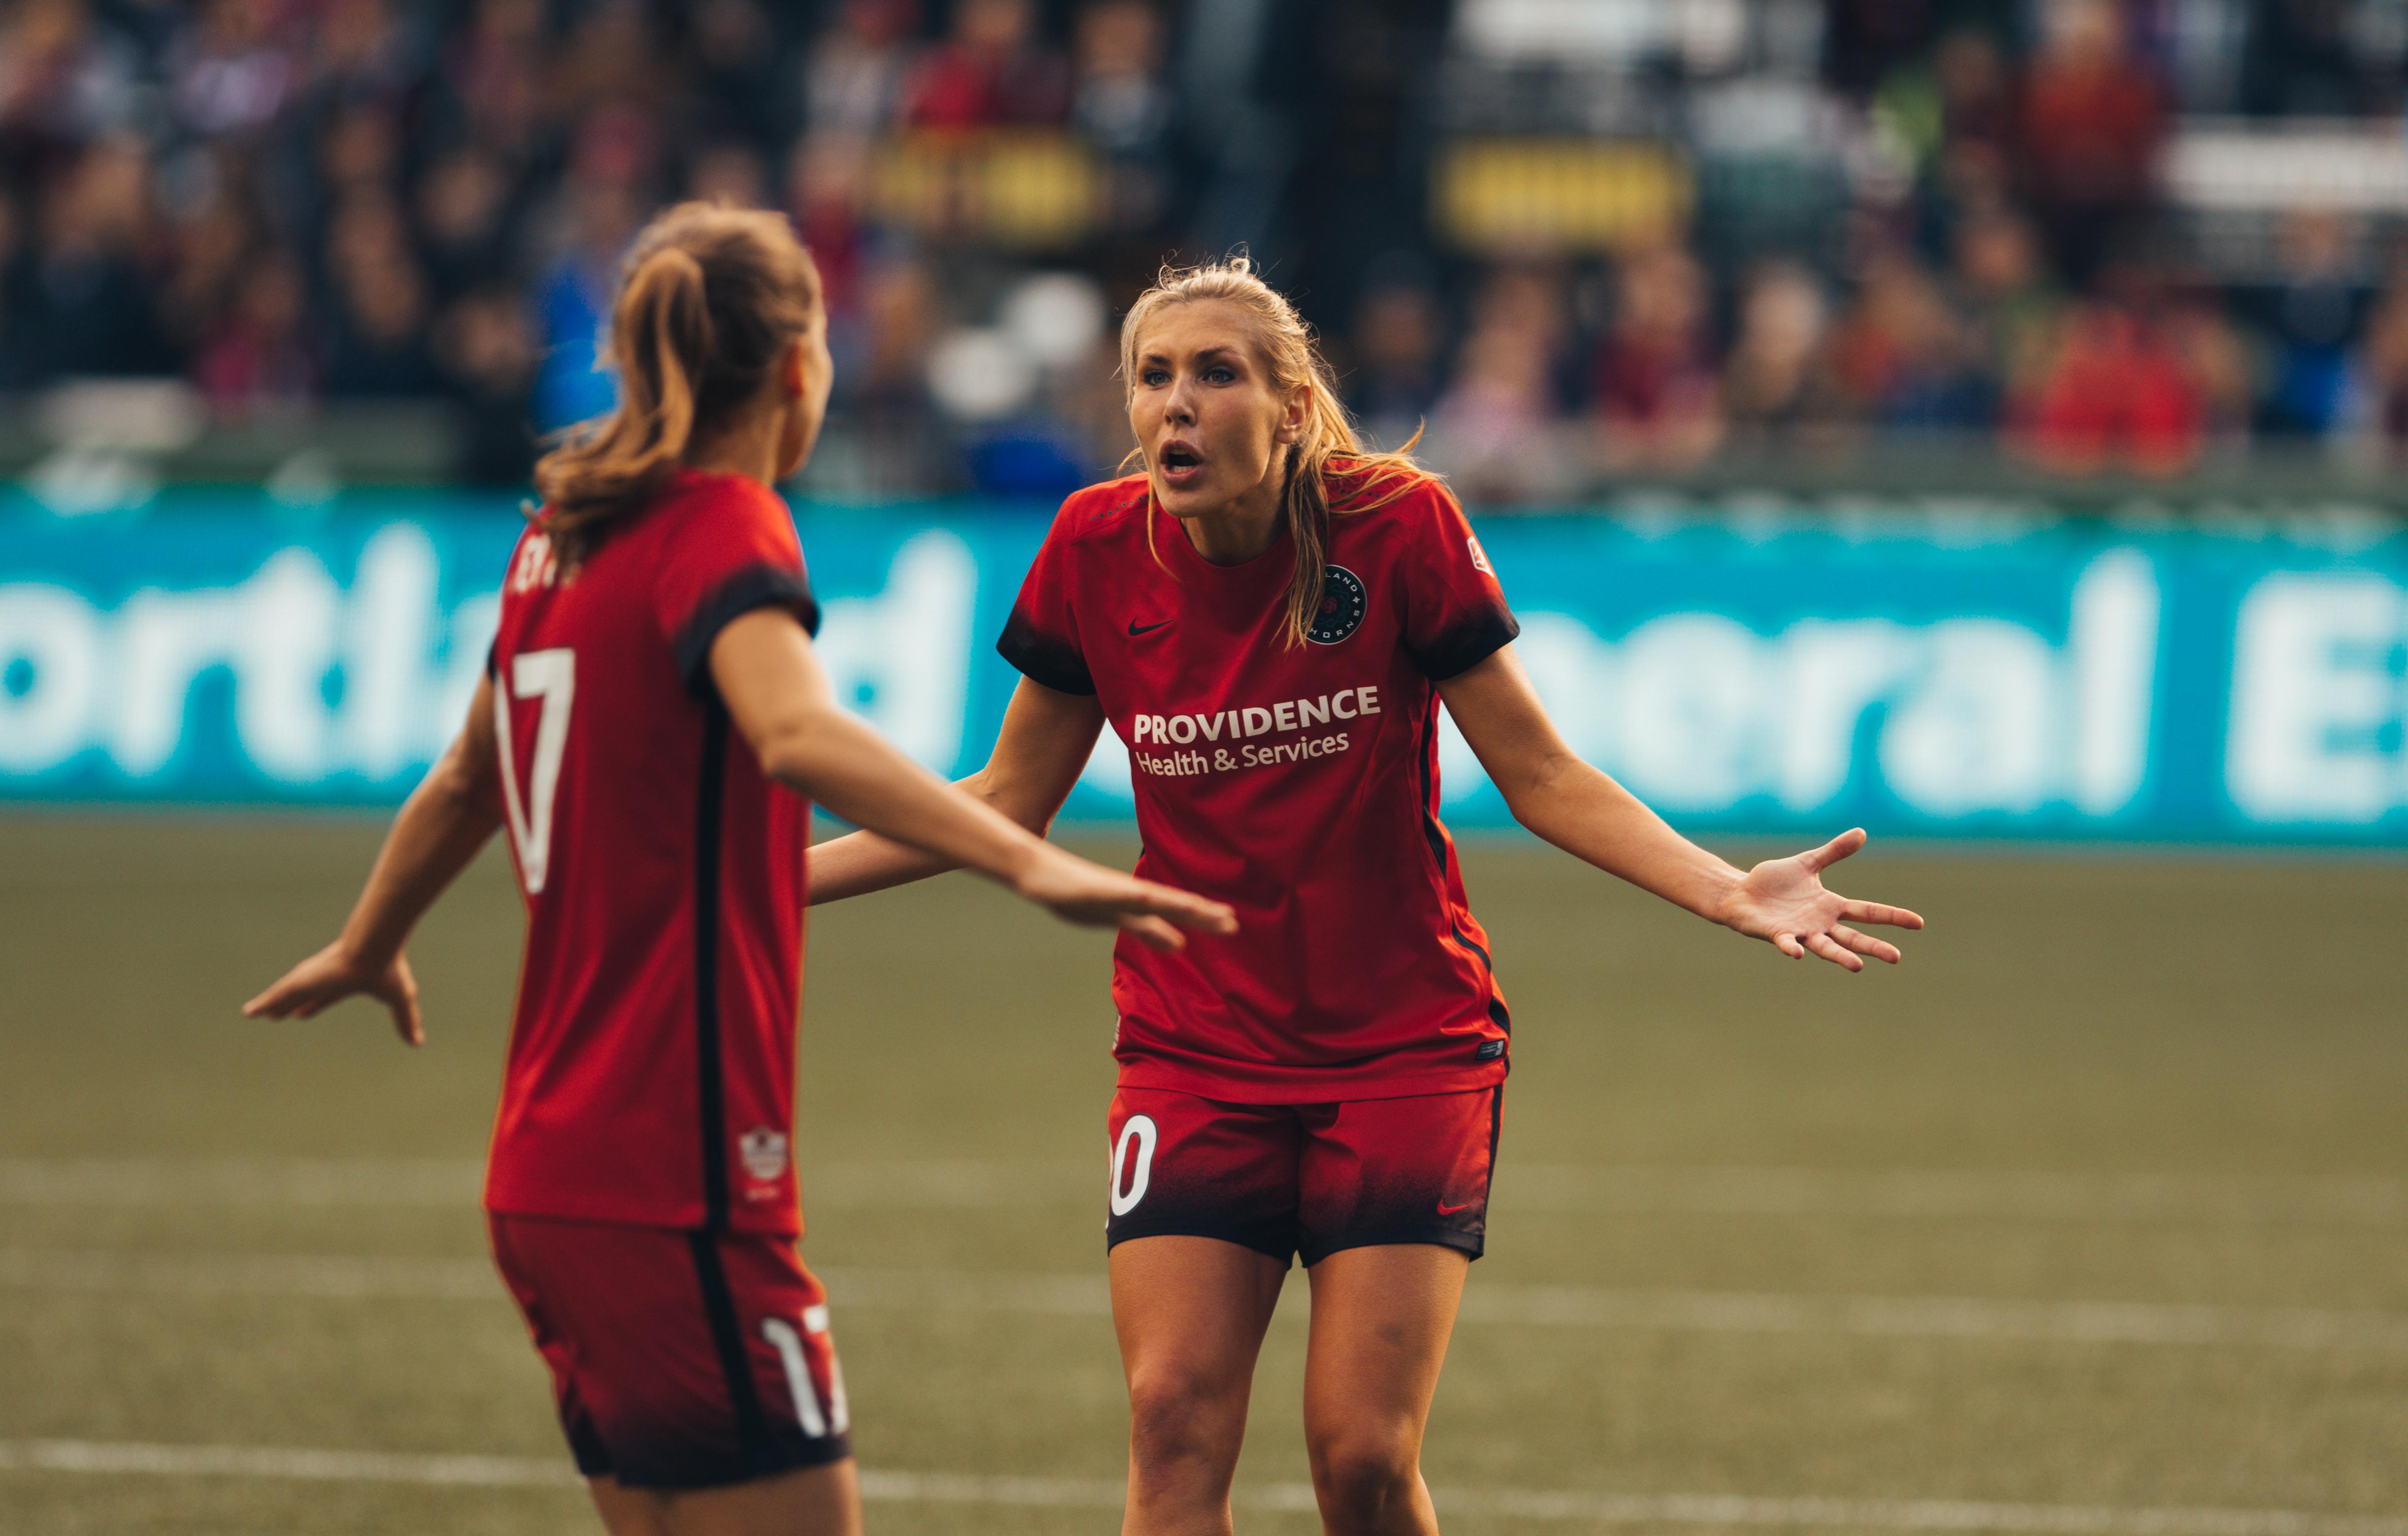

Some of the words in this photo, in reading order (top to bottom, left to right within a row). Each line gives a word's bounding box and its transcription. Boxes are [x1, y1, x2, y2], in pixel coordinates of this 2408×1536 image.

[1325, 572, 1358, 592] LAND
[1304, 610, 1361, 639] HORNS
[1134, 686, 1381, 745] PROVIDENCE
[2226, 570, 2408, 822] E
[1135, 749, 1209, 776] Health
[1214, 748, 1238, 771] &
[1241, 733, 1349, 768] Services
[1109, 1112, 1159, 1218] 0
